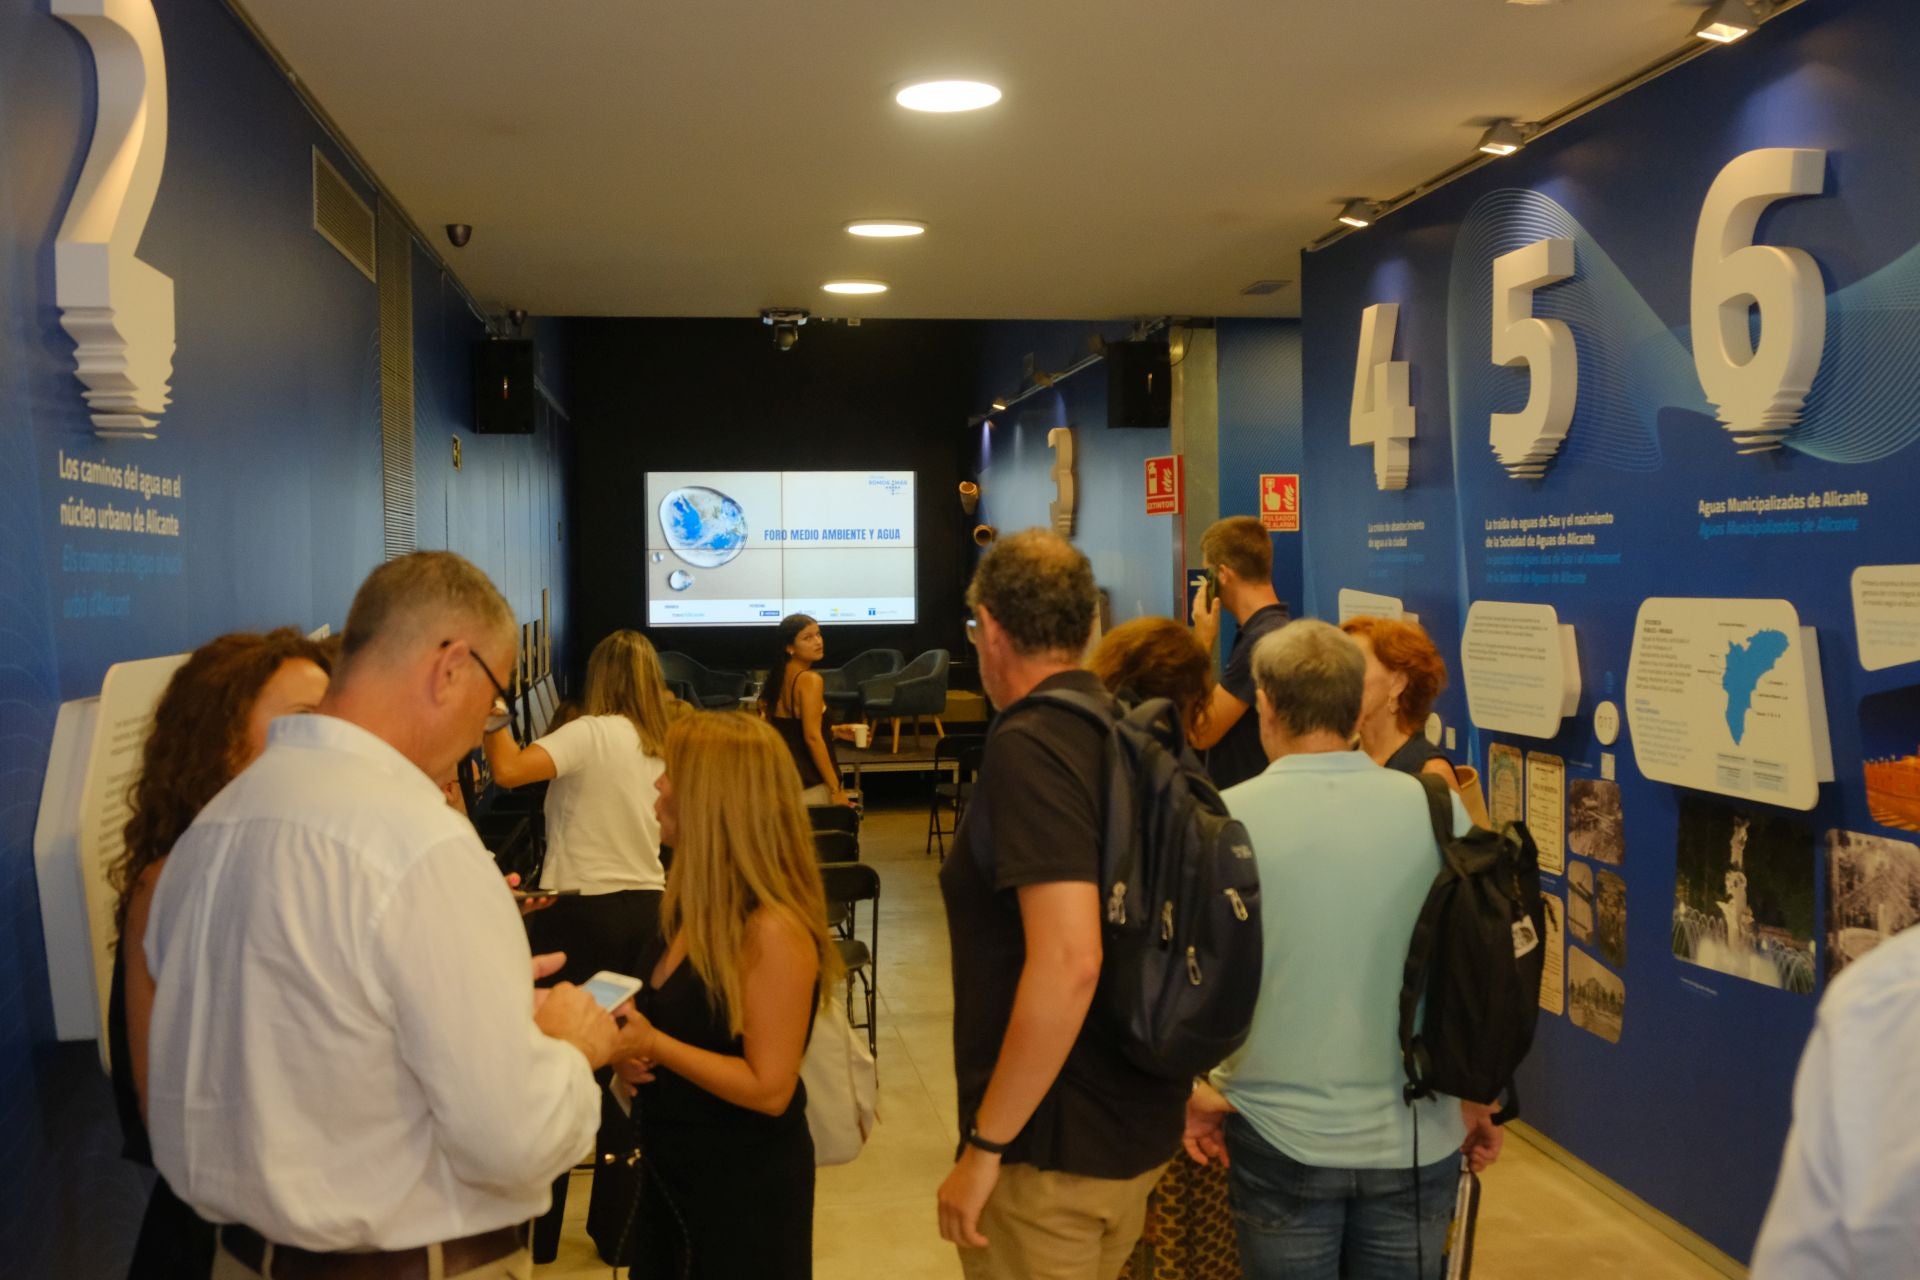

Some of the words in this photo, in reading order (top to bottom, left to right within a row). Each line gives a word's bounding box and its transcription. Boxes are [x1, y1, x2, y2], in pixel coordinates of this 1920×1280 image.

[1691, 147, 1827, 454] 6
[1490, 238, 1578, 480] 5
[1350, 303, 1416, 491] 4
[59, 449, 79, 481] Los
[80, 458, 122, 489] caminos
[123, 463, 139, 491] del
[139, 472, 161, 501] agua
[161, 477, 173, 497] en
[173, 473, 182, 499] el
[60, 496, 96, 529] núcleo
[98, 503, 132, 532] urbano
[133, 507, 145, 533] de
[146, 509, 179, 536] Alicante
[1510, 517, 1518, 529] de
[1519, 518, 1538, 532] aguas
[1539, 515, 1547, 528] de
[1548, 515, 1560, 527] Sax
[1574, 512, 1614, 525] nacimiento
[1698, 499, 1726, 518] Aguas
[1727, 494, 1806, 515] Municipalizadas
[1807, 491, 1821, 508] de
[1822, 490, 1868, 507] Alicante
[764, 529, 787, 541] FORO
[790, 528, 819, 541] MEDIO
[822, 528, 866, 540] AMBIENTE
[869, 528, 875, 540] Y
[877, 528, 901, 540] AGUA
[1485, 537, 1493, 548] de
[1500, 535, 1526, 547] Sociedad
[1527, 535, 1535, 547] de
[1535, 534, 1556, 550] Aguas
[1557, 533, 1566, 546] de
[1567, 532, 1595, 545] Alicante
